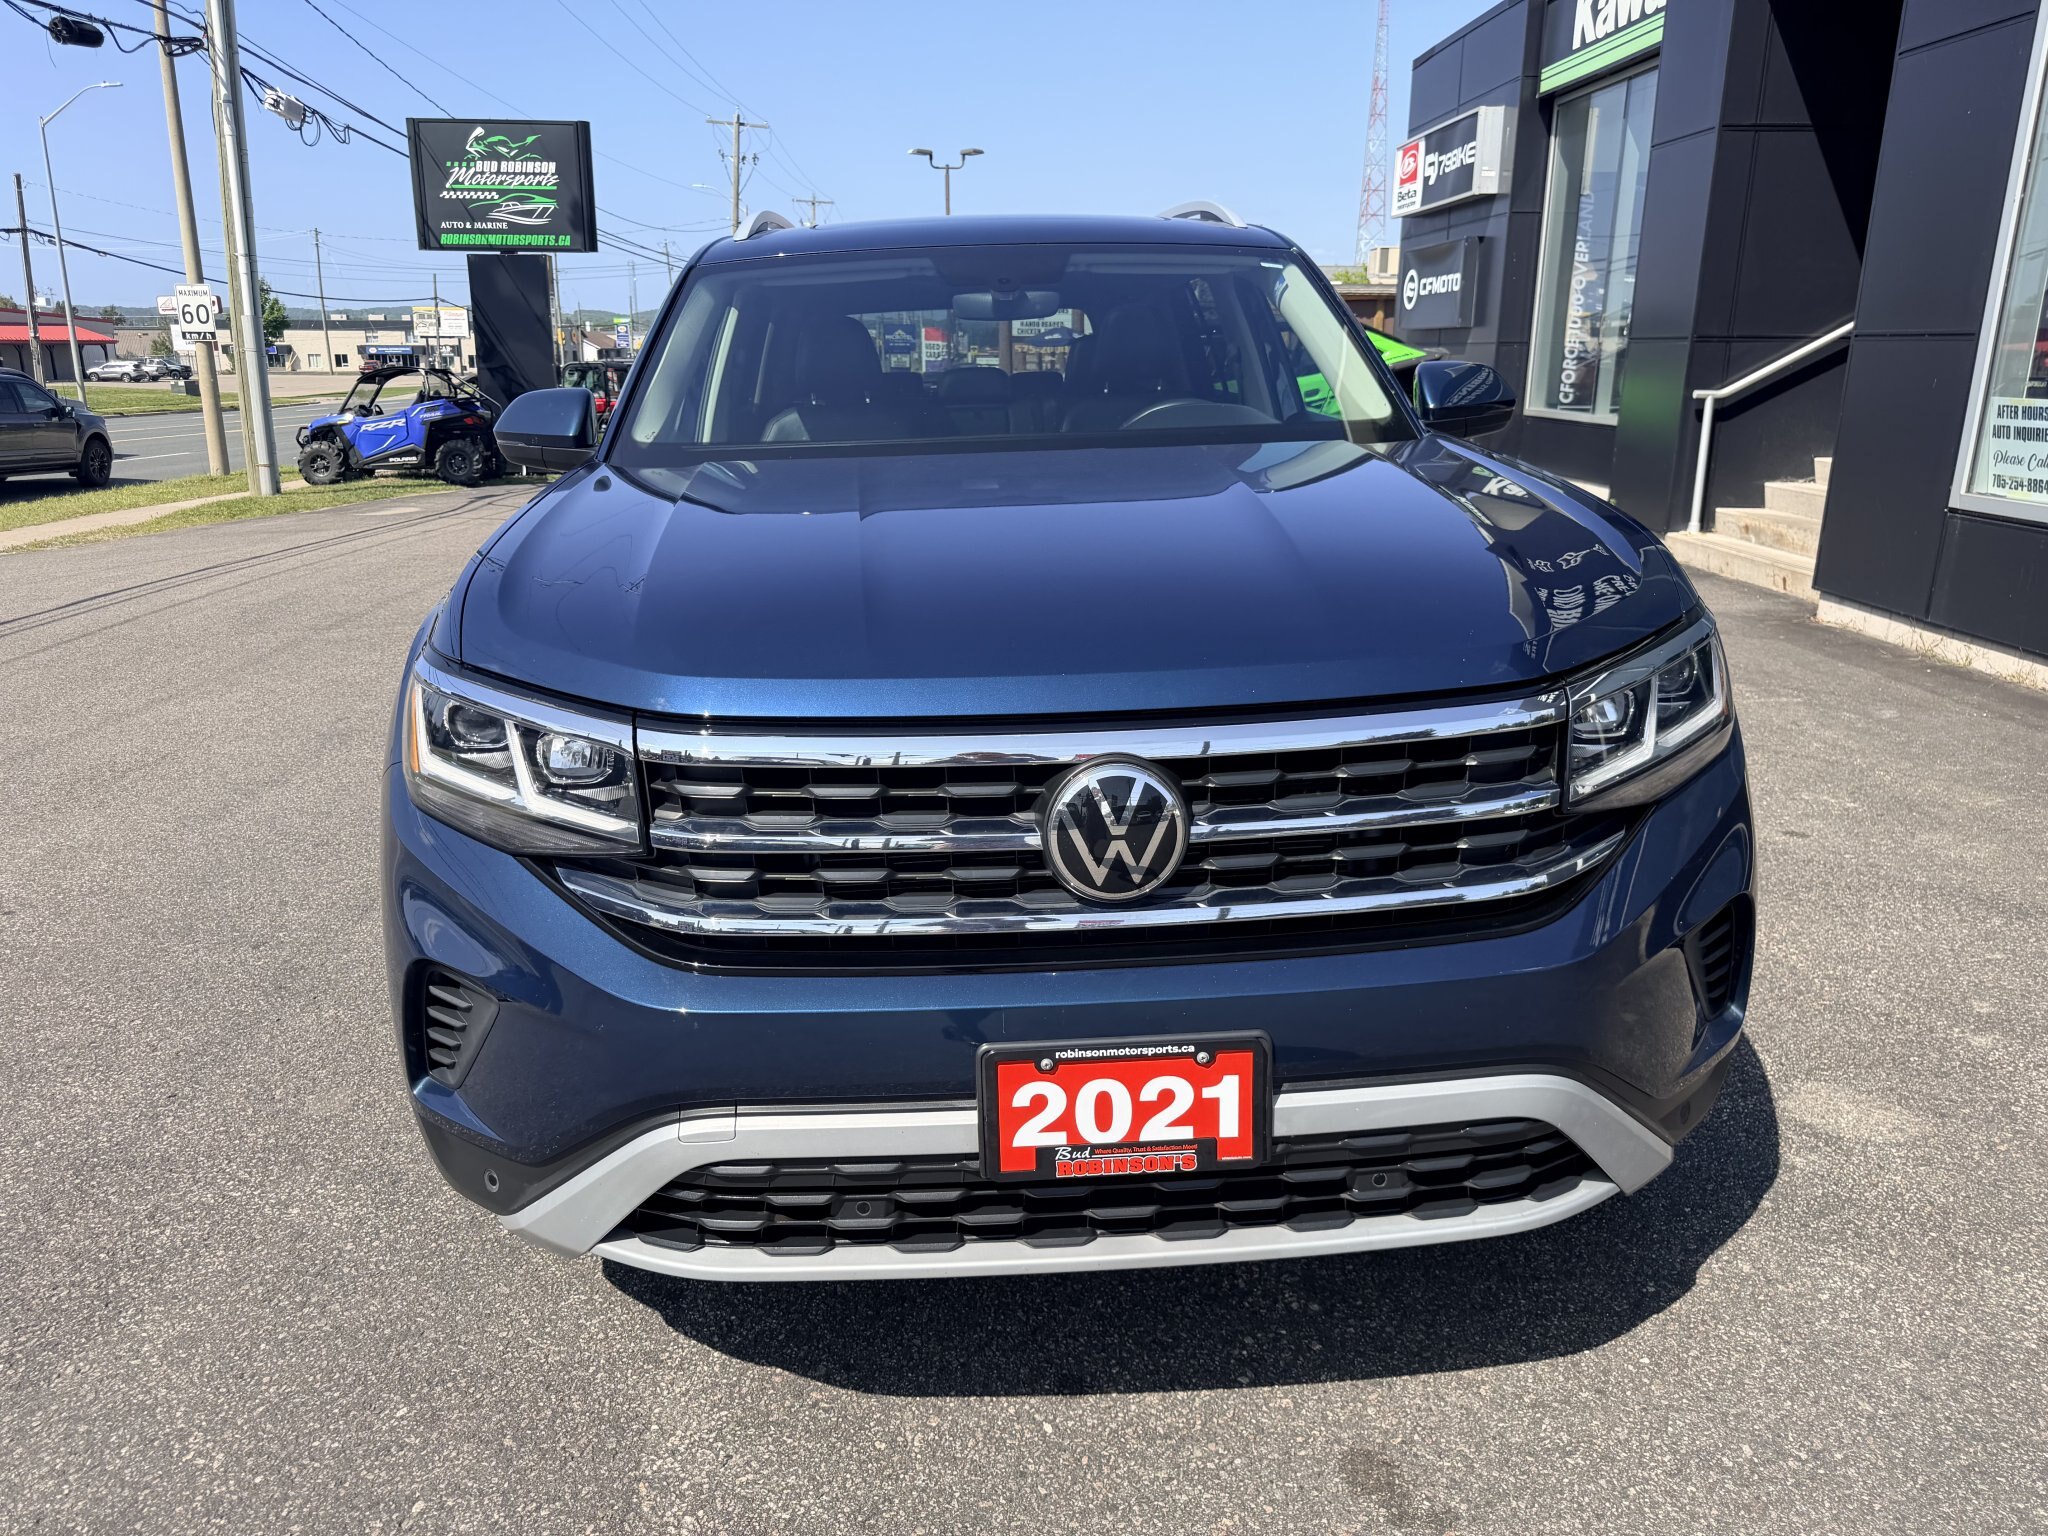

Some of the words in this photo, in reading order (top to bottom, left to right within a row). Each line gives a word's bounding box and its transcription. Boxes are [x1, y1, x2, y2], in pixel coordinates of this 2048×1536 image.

[475, 160, 498, 173] BUD
[500, 161, 556, 173] ROBINSON
[446, 167, 560, 189] Motorsports
[1397, 188, 1417, 203] Beta
[440, 221, 464, 229] AUTO
[474, 222, 509, 230] MARINE
[440, 233, 571, 246] ROBINSONMOTORSPORTS.CA
[1419, 272, 1461, 296] CFMOTO
[178, 289, 209, 297] MAXIMUM
[181, 303, 210, 325] 60
[185, 332, 212, 340] km/h
[1997, 404, 2019, 420] AFTER
[360, 418, 406, 432] RZR
[1992, 424, 2011, 440] AUTO
[1993, 449, 2025, 467] Please
[1055, 1045, 1195, 1059] robinsonmotorsports.ca
[1011, 1074, 1240, 1147] 2021
[1055, 1145, 1091, 1161] Bud
[1055, 1153, 1198, 1178] ROBINSON'S
